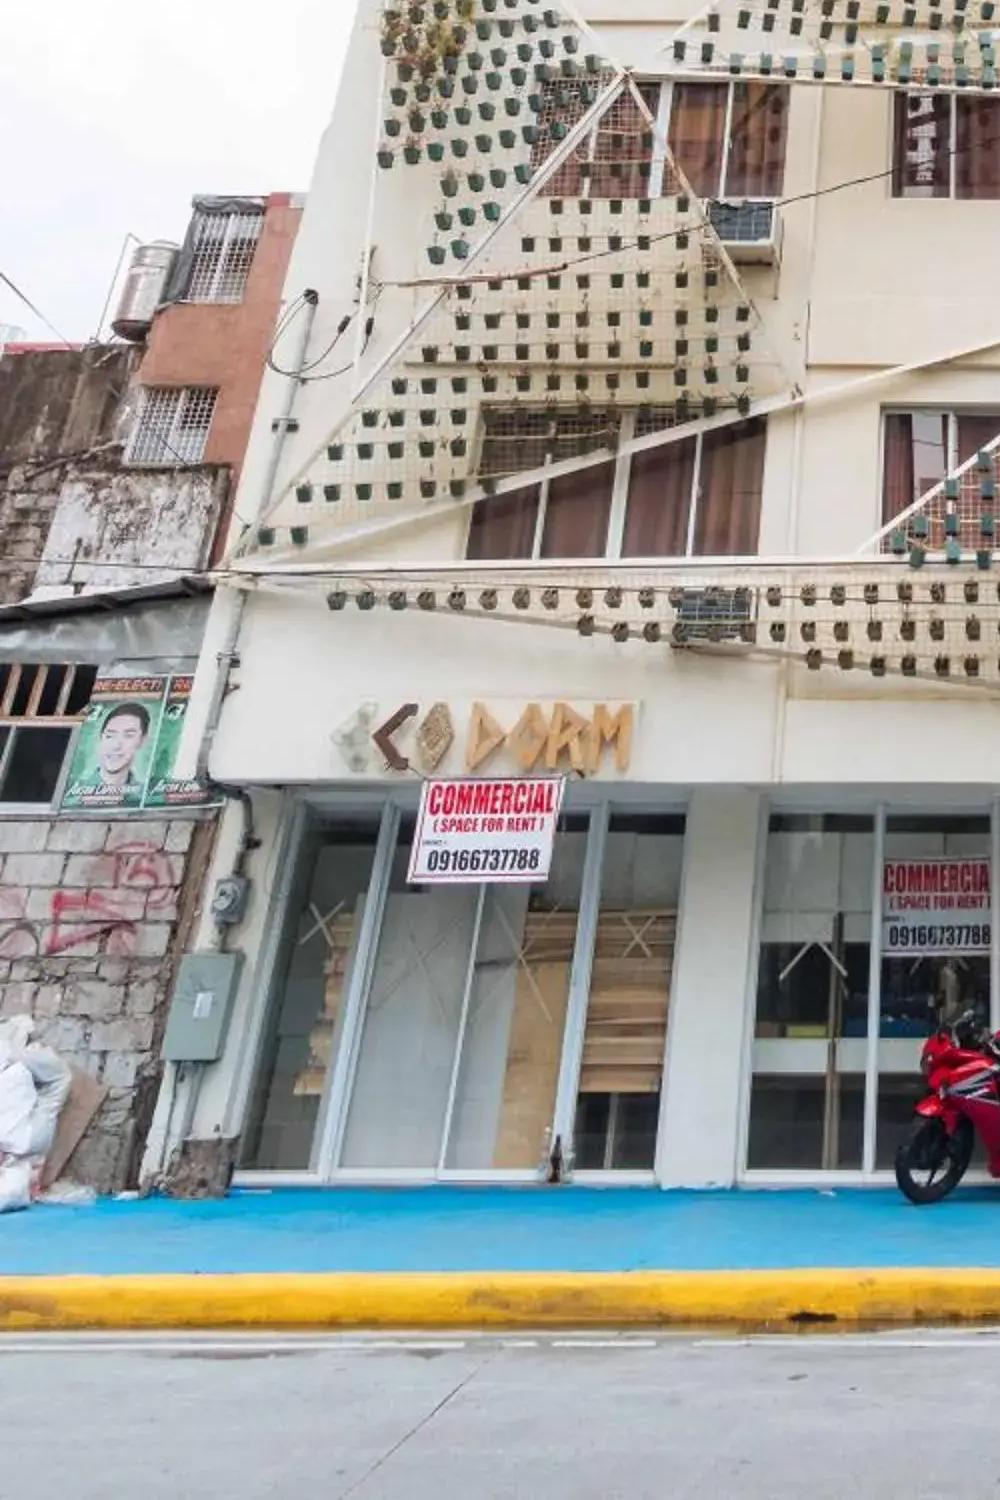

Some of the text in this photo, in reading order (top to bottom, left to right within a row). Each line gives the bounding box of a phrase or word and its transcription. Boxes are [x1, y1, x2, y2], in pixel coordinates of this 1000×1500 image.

[466, 701, 635, 772] DORM
[429, 783, 555, 816] COMMERCIAL
[440, 817, 480, 833] SPACE
[481, 817, 505, 833] FOR
[506, 817, 537, 833] RENT
[427, 848, 541, 872] 09166737788
